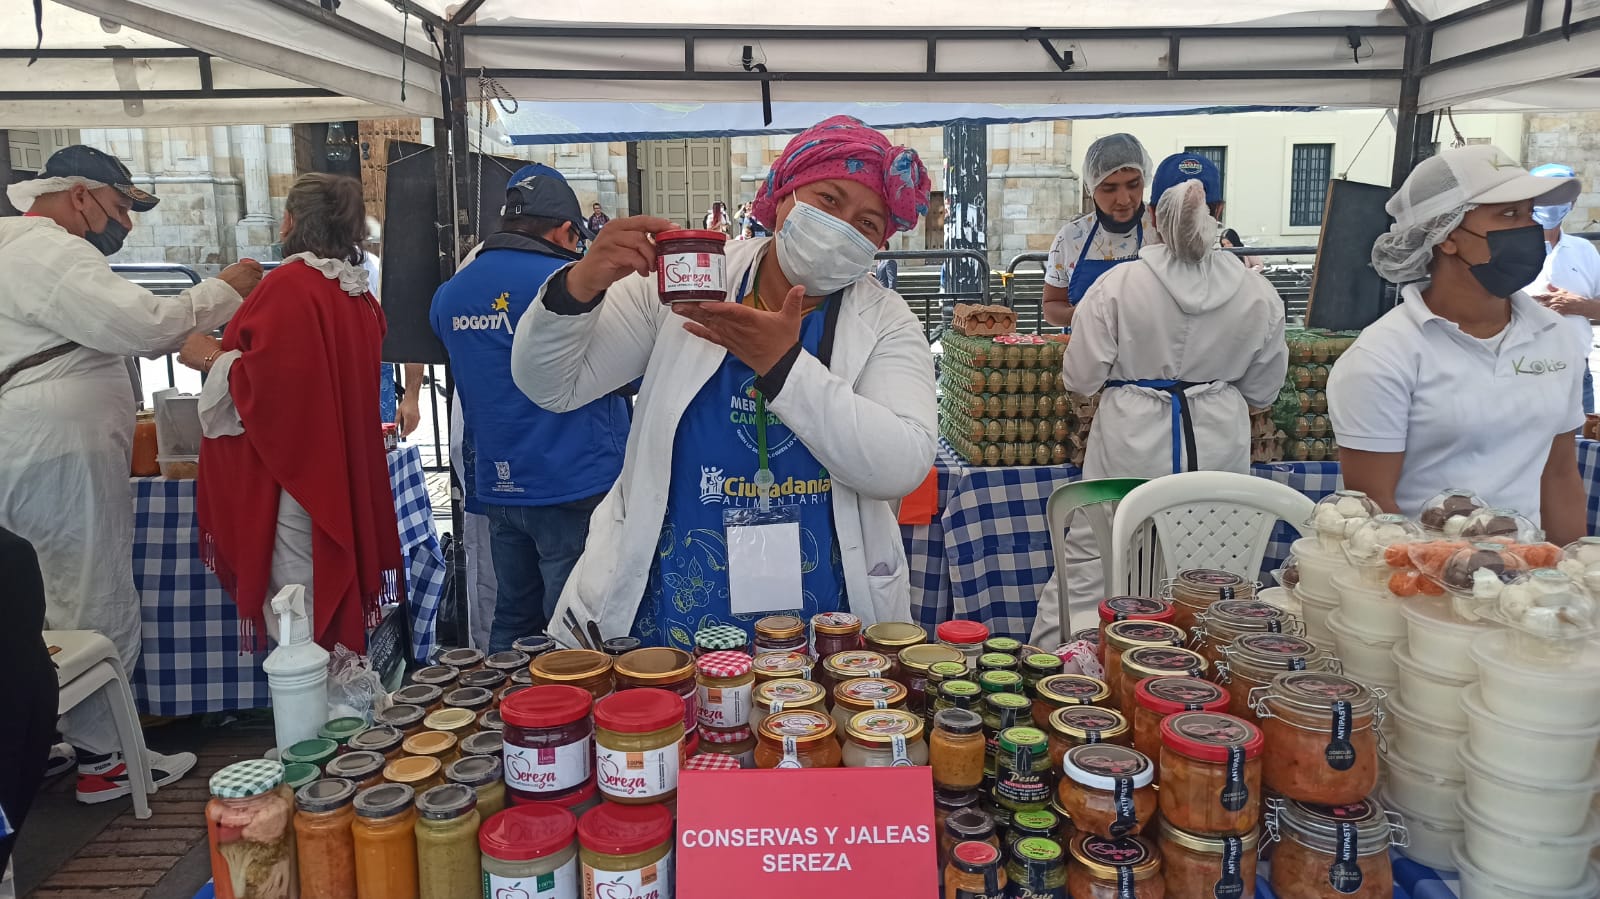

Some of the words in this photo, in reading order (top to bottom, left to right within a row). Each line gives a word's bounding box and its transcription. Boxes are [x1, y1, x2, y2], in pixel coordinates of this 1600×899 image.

[1337, 700, 1346, 740] ANTIPASTO
[511, 760, 557, 790] Sereza
[601, 762, 647, 795] Sereza
[1008, 771, 1041, 783] Pesto
[681, 826, 818, 848] CONSERVAS
[823, 826, 839, 845] Y
[844, 824, 931, 845] JALEAS
[762, 852, 852, 873] SEREZA
